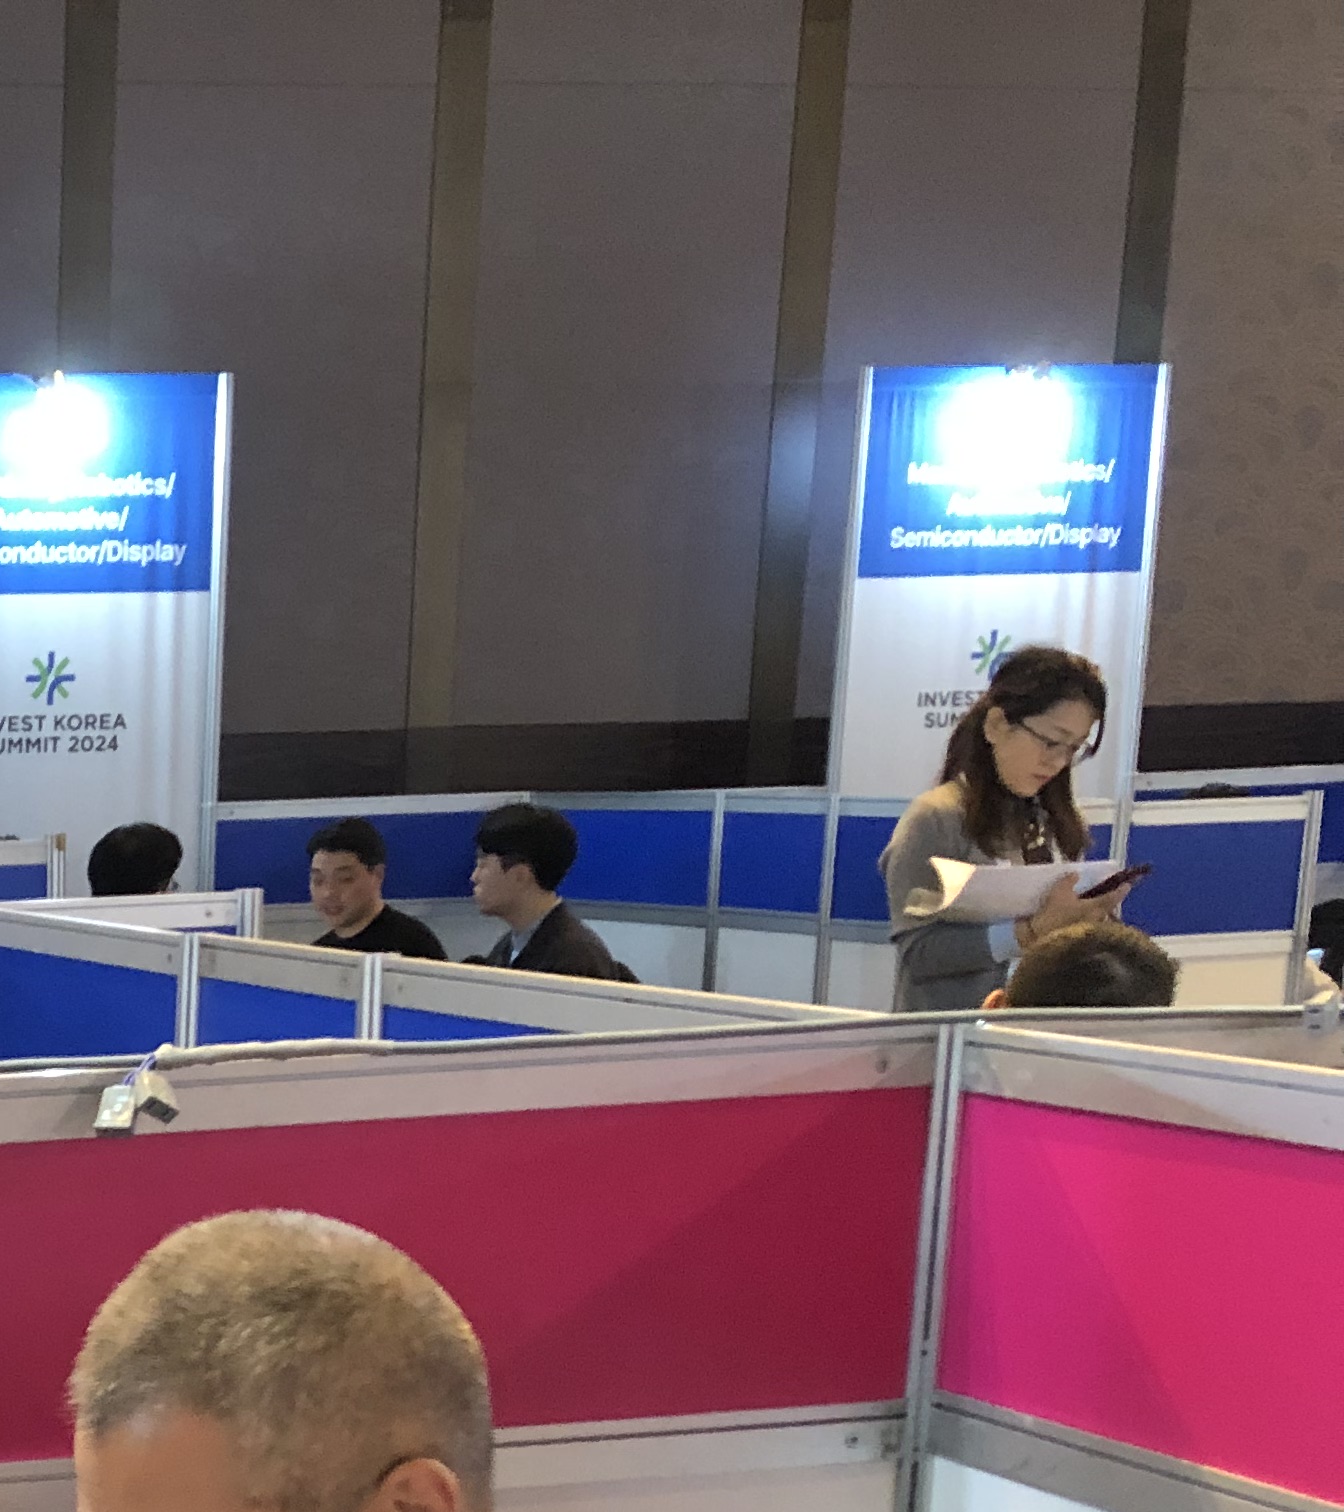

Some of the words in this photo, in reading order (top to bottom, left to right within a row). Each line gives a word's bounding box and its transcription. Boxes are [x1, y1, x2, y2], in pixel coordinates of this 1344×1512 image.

[890, 522, 1122, 549] Semiconductor/Display
[53, 712, 128, 731] KOREA
[67, 734, 119, 753] 2024
